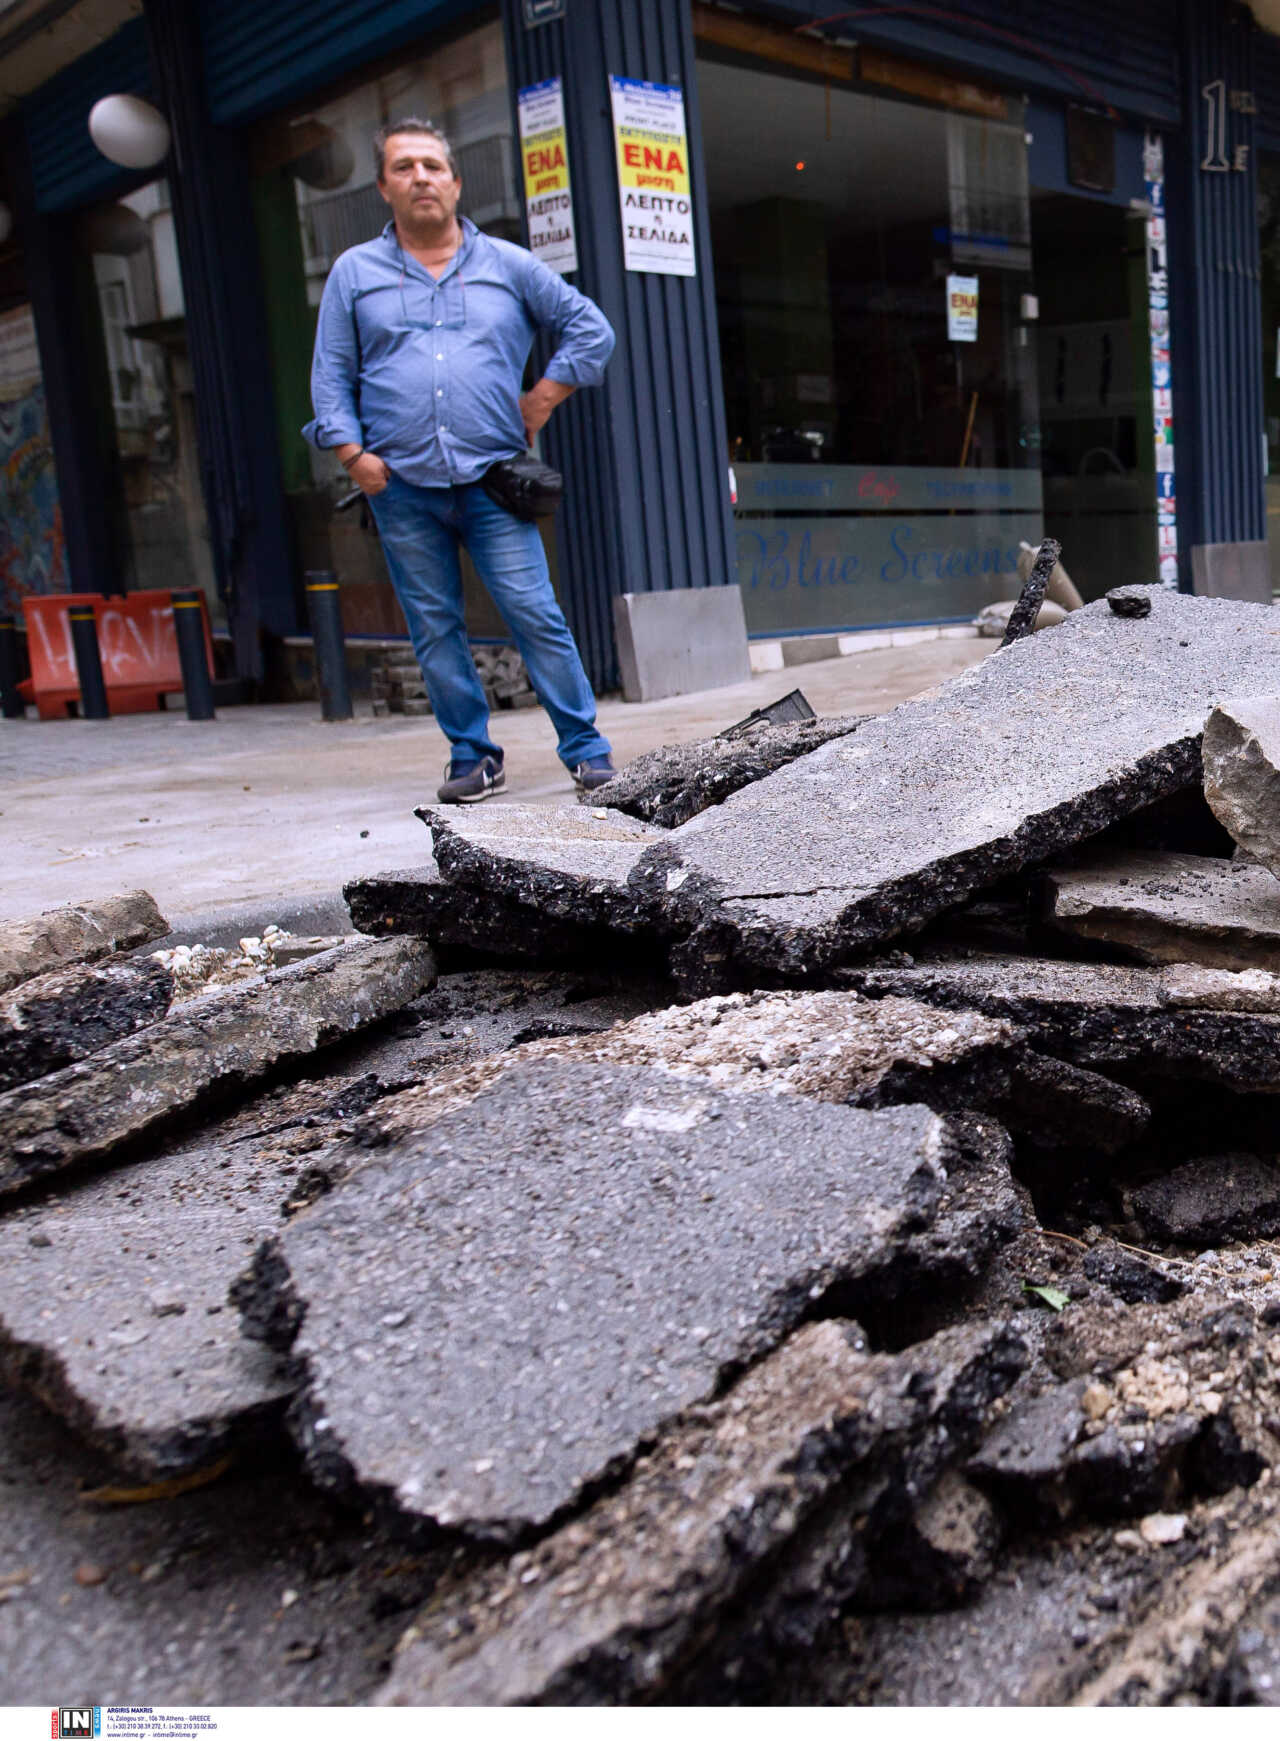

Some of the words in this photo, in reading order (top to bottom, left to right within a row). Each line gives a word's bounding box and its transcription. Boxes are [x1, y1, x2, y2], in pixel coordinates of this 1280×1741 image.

[1202, 79, 1230, 171] 1
[527, 144, 566, 177] ΕΝΑ
[623, 143, 685, 174] ΕΝΑ
[625, 193, 689, 215] ΛΕΠΤΟ
[628, 225, 690, 245] ΣΕΛΙΔΑ
[735, 528, 858, 592] Blue
[879, 524, 1020, 583] Screens
